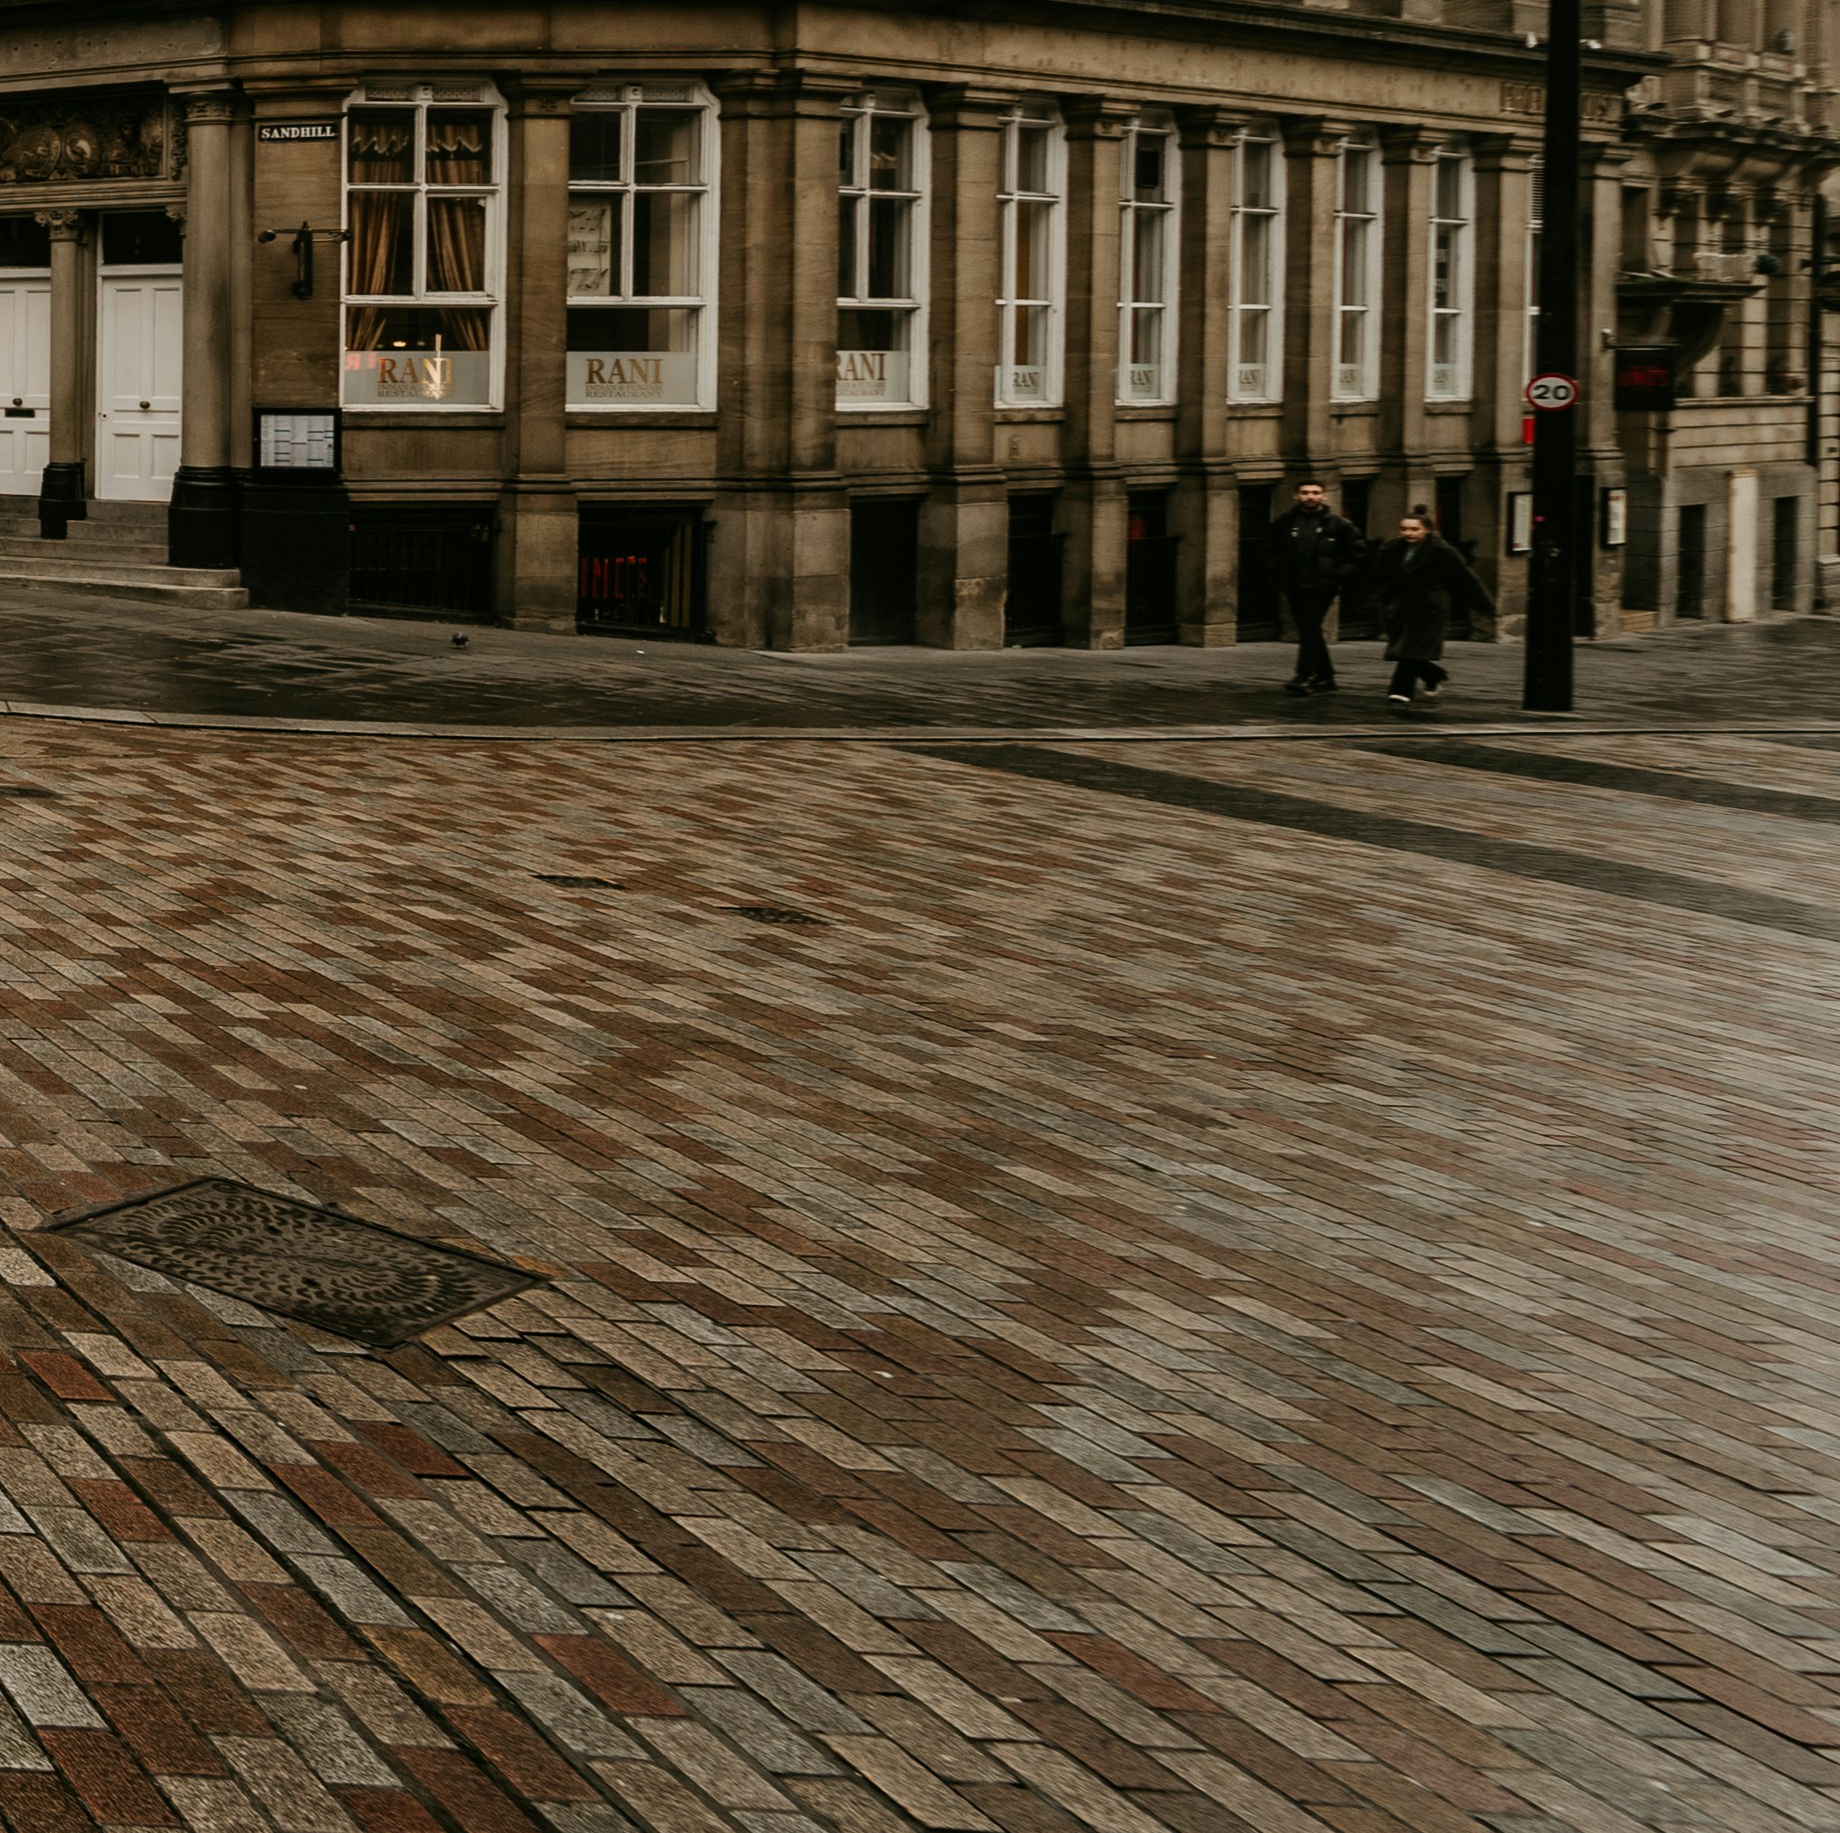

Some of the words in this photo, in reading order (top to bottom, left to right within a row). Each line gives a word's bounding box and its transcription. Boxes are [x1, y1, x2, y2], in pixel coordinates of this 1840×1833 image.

[261, 126, 335, 139] SANDHILL
[378, 357, 453, 384] RANI
[585, 358, 664, 384] RANI
[1532, 384, 1570, 401] 20
